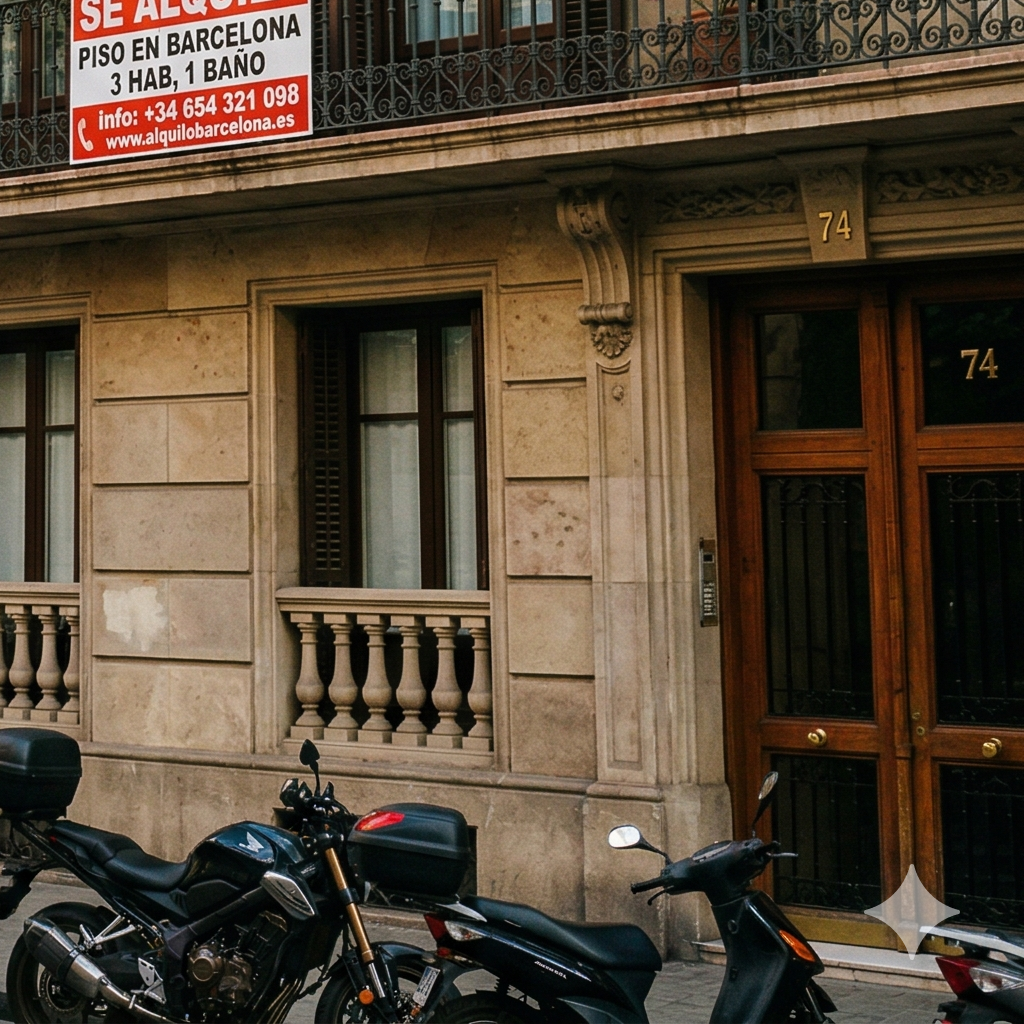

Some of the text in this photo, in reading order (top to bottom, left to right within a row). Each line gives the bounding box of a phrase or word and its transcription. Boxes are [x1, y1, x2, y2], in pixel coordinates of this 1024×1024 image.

[78, 13, 301, 70] PISO EN BARCELONA
[110, 48, 266, 96] 3 HAB, 1 BAÑO
[98, 83, 300, 130] info: +34 654 321 098
[105, 113, 295, 150] www.alquilobarcelona.es
[818, 210, 852, 243] 74
[960, 348, 998, 380] 74
